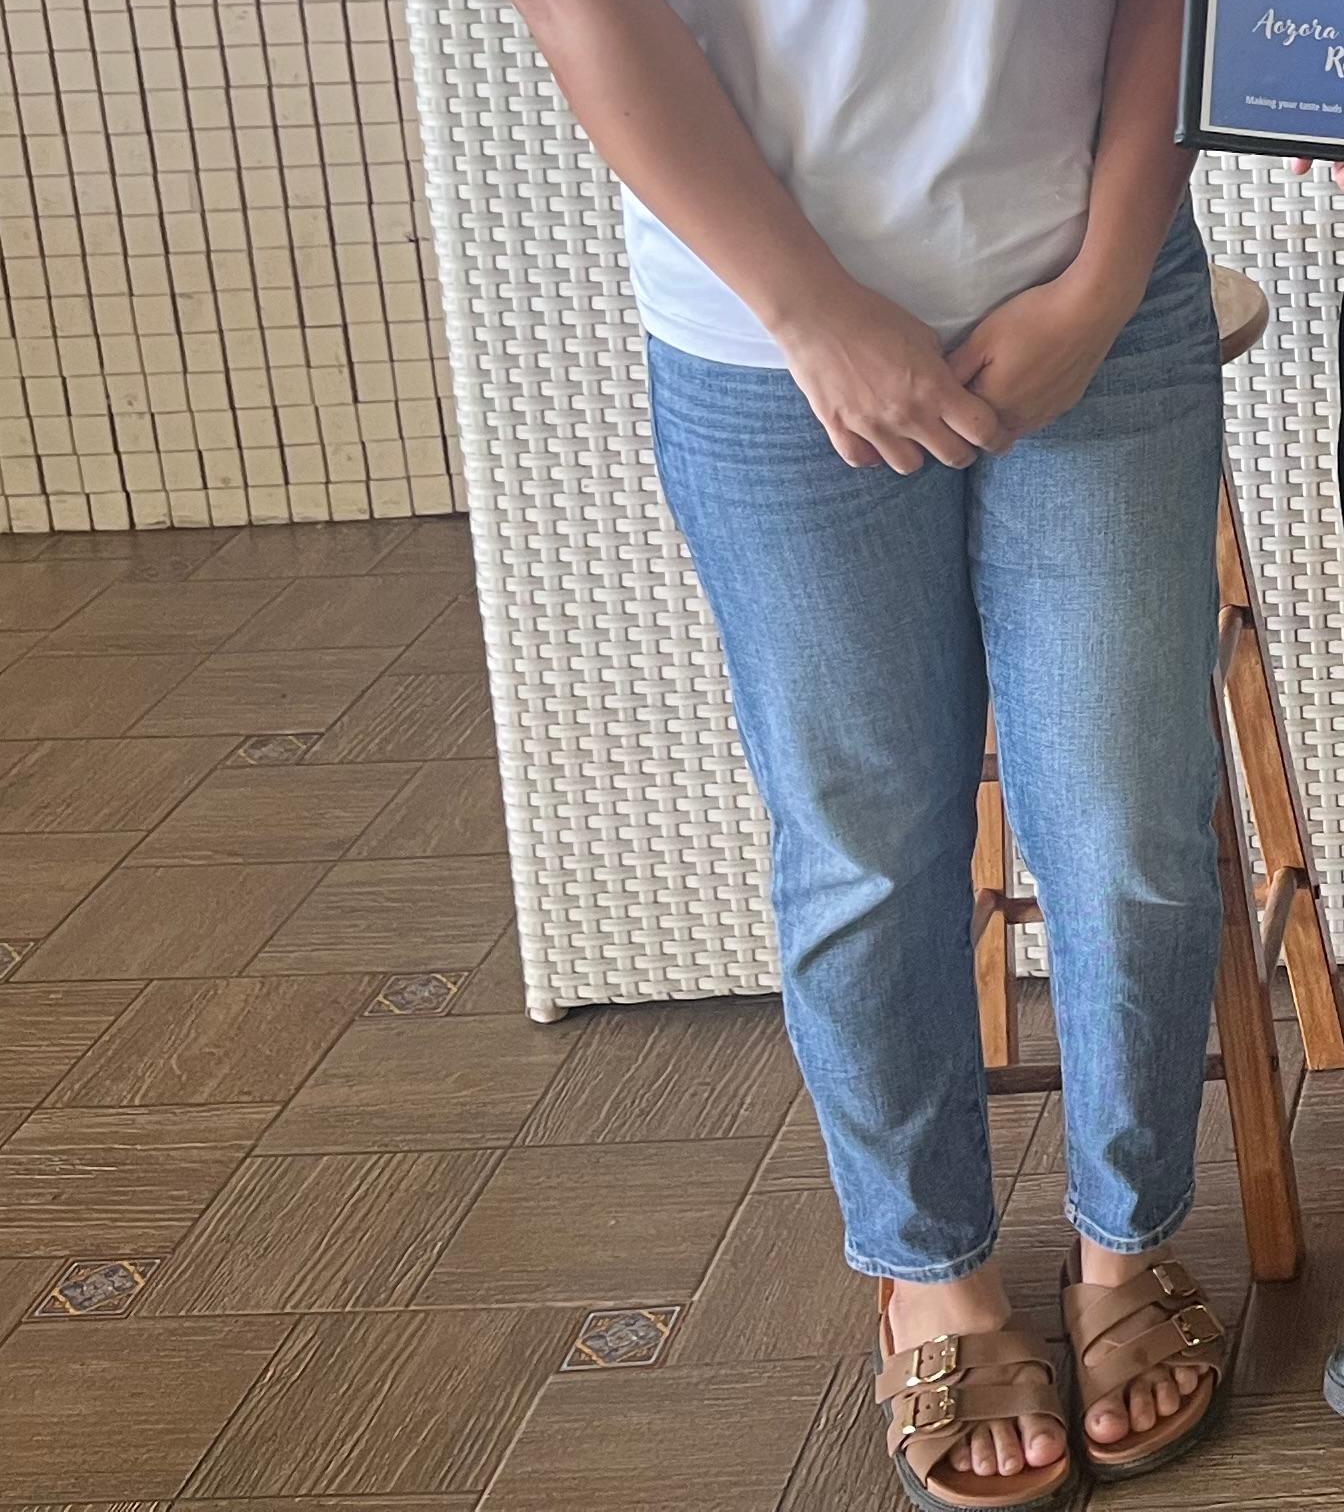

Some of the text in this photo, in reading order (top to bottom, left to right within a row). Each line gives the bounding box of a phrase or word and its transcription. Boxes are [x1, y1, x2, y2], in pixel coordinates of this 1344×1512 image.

[1252, 8, 1339, 46] Aozora
[1246, 95, 1277, 110] Making
[1278, 100, 1298, 110] your
